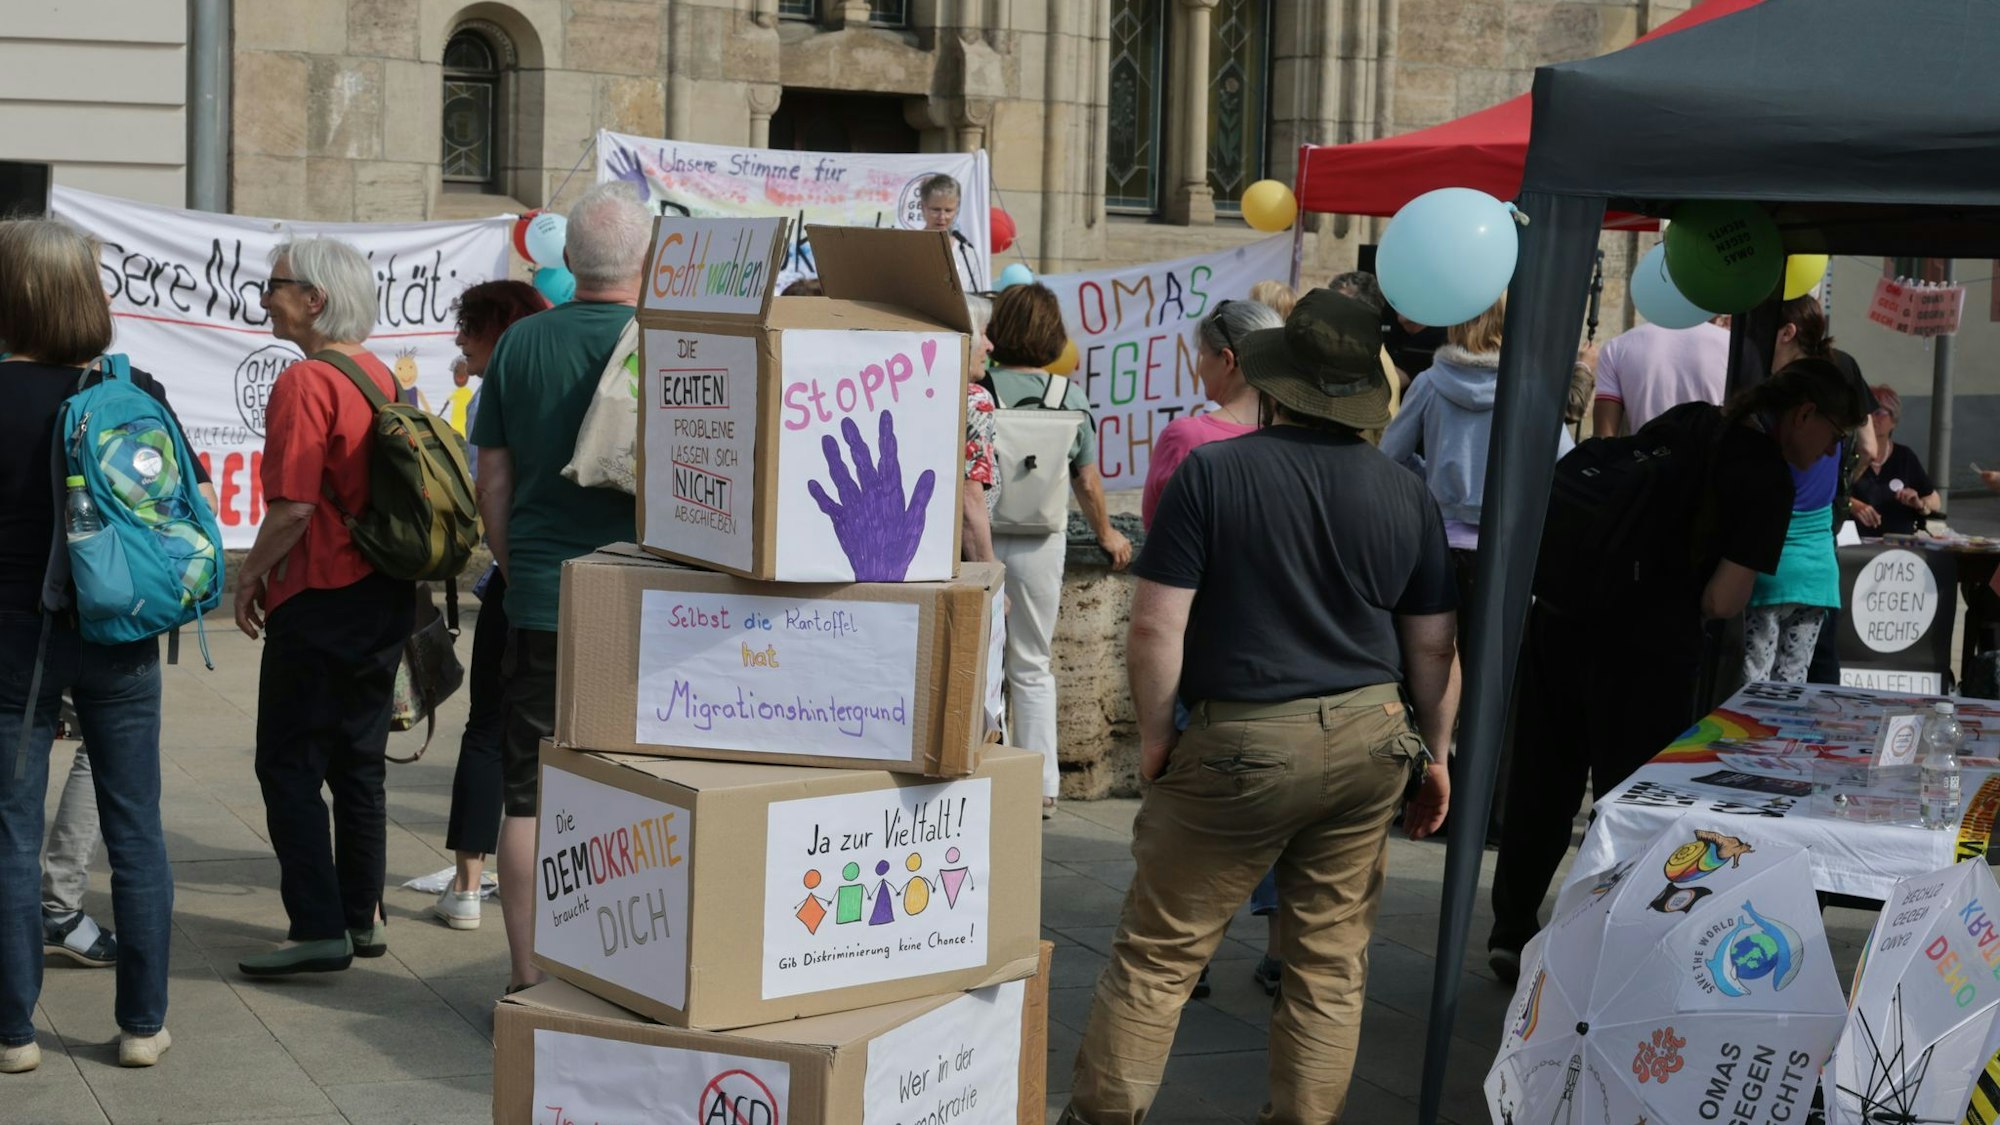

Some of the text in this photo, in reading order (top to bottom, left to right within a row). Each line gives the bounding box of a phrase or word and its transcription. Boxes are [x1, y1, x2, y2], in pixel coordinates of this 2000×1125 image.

[659, 148, 847, 182] Unsere Stimme für
[100, 241, 197, 313] sere
[653, 229, 713, 299] Geht
[1078, 265, 1212, 335] OMAS
[677, 339, 698, 359] DIE
[784, 339, 938, 431] Stopp!
[1074, 333, 1201, 409] EGEN
[664, 375, 724, 406] ECHTEN
[186, 426, 248, 446] AALFELD
[674, 418, 735, 440] PROBLEME
[671, 444, 738, 467] LASSEN SICH
[675, 468, 727, 510] NICHT
[674, 505, 737, 535] ABSCHIEBEN
[1874, 562, 1915, 583] OMAS
[1866, 592, 1925, 612] GEGEN
[667, 604, 858, 639] Selbst die Kartoffel
[1867, 621, 1920, 642] RECHTS
[741, 641, 780, 668] hat
[656, 679, 906, 738] Migrationshintergrund
[555, 809, 576, 835] Die
[807, 797, 967, 856] Ja zur Vielfalt!
[542, 812, 682, 902] DEMOKRATIE
[552, 893, 591, 928] braucht
[597, 888, 671, 957] DICH
[778, 957, 798, 970] Gib
[803, 942, 890, 967] Diskriminierung
[898, 936, 922, 952] keine
[1692, 918, 1735, 995] SAVE THE WORLD
[899, 1043, 975, 1104] Wer in der
[1699, 1042, 1741, 1120] OMAS
[1766, 1050, 1810, 1125] CHTS
